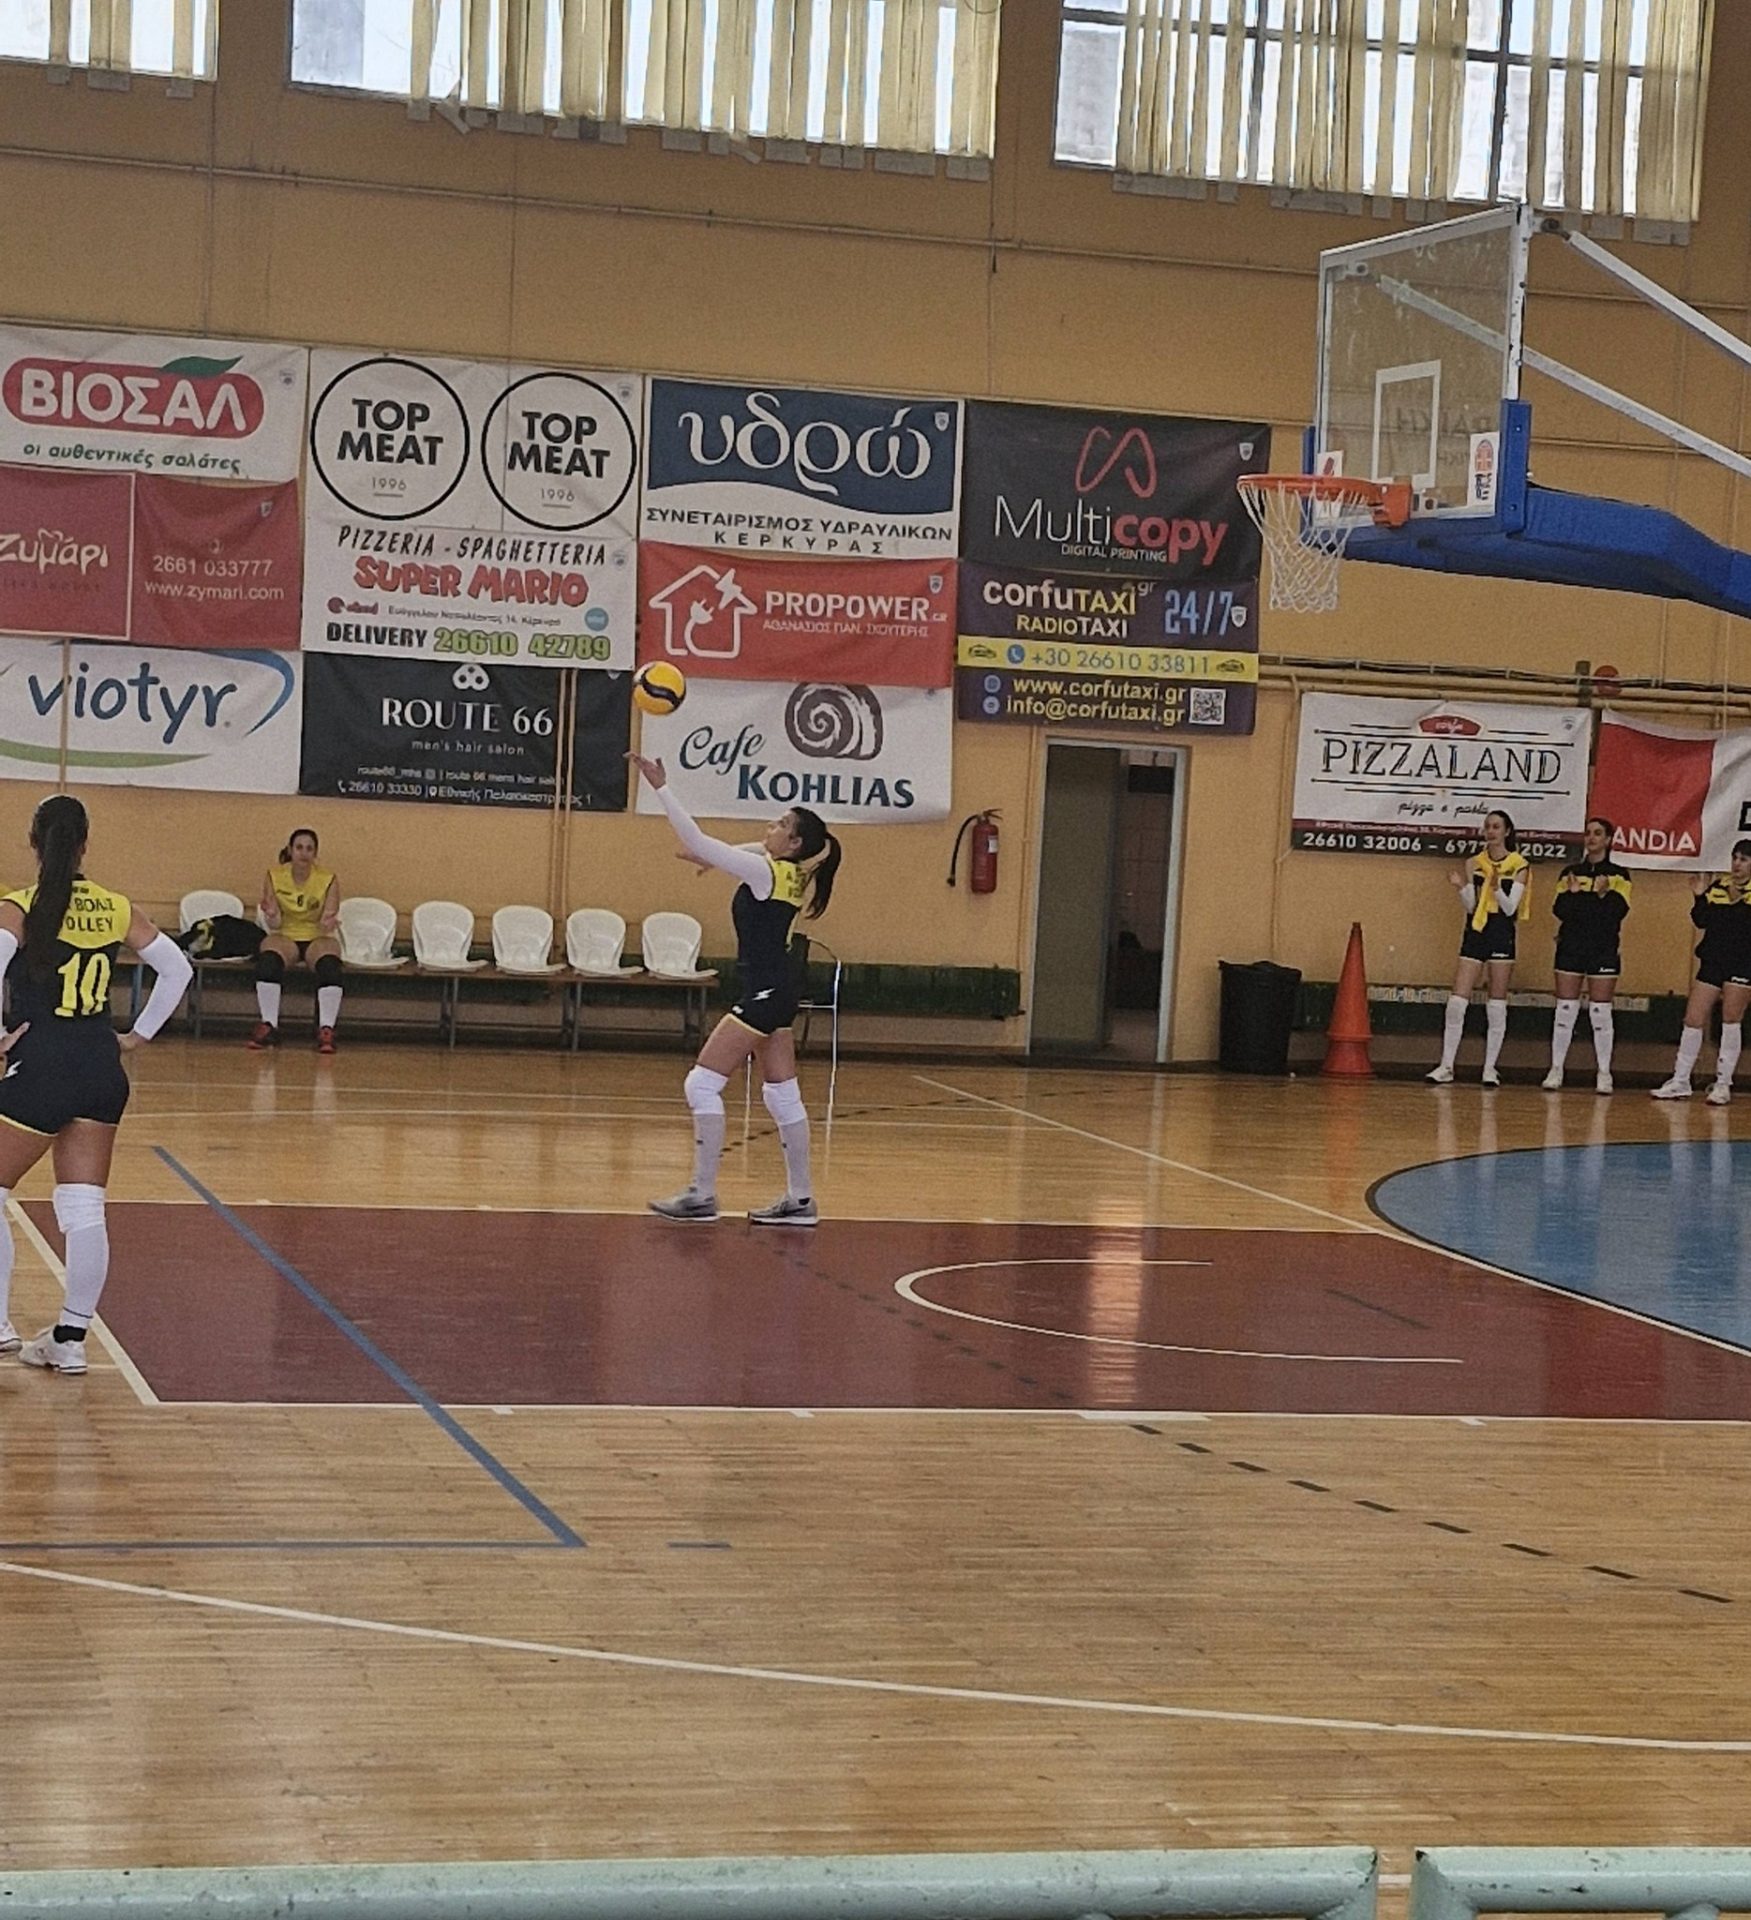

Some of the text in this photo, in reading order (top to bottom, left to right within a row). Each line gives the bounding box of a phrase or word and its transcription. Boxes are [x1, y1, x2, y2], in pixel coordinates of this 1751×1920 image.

[20, 368, 247, 432] ΒΙΟΣΑΛ
[352, 398, 430, 431] TOP
[522, 410, 598, 445] TOP
[678, 391, 931, 497] υδρώ
[23, 443, 241, 475] οι αυθεντικές σαλάτες
[337, 430, 444, 466] MEAT
[508, 441, 611, 479] MEAT
[372, 476, 407, 491] 1996
[541, 488, 575, 502] 1996
[646, 507, 953, 541] ΣΥΝΕΤΑΙΡΙΣΜΟΣ ΥΔΡΑΥΛΙΚΩΝ
[995, 494, 1228, 566] Multicopy
[338, 525, 436, 556] PIZZERIA
[457, 536, 606, 566] SPAGHETTERIA
[1061, 543, 1167, 562] DIGITAL PRINTING
[153, 555, 273, 577] 2661 033777
[354, 555, 589, 607] SUPER MARIO
[144, 580, 285, 601] www.zymari.com
[766, 590, 931, 621] PROPOWER
[1016, 614, 1128, 638] RADIOTAXI
[1164, 589, 1233, 636] 24/7
[327, 622, 611, 660] DELIVERY 26610 42789
[1032, 650, 1209, 674] +30 26610 33811
[28, 662, 237, 744] viotyr
[1013, 677, 1187, 701] www.corfutaxi.gr
[381, 698, 553, 736] ROUTE 66
[1007, 695, 1185, 725] info@corfutaxi.gr
[411, 739, 525, 756] men's hair salon
[679, 723, 767, 775] Cafe
[1321, 737, 1562, 784] PIZZALAND
[737, 763, 916, 809] KOHLIAS
[1303, 832, 1357, 848] 26610
[1363, 835, 1422, 852] 32006
[1611, 825, 1697, 852] ANDIA
[66, 916, 113, 932] OLLEY
[54, 951, 111, 1018] 10
